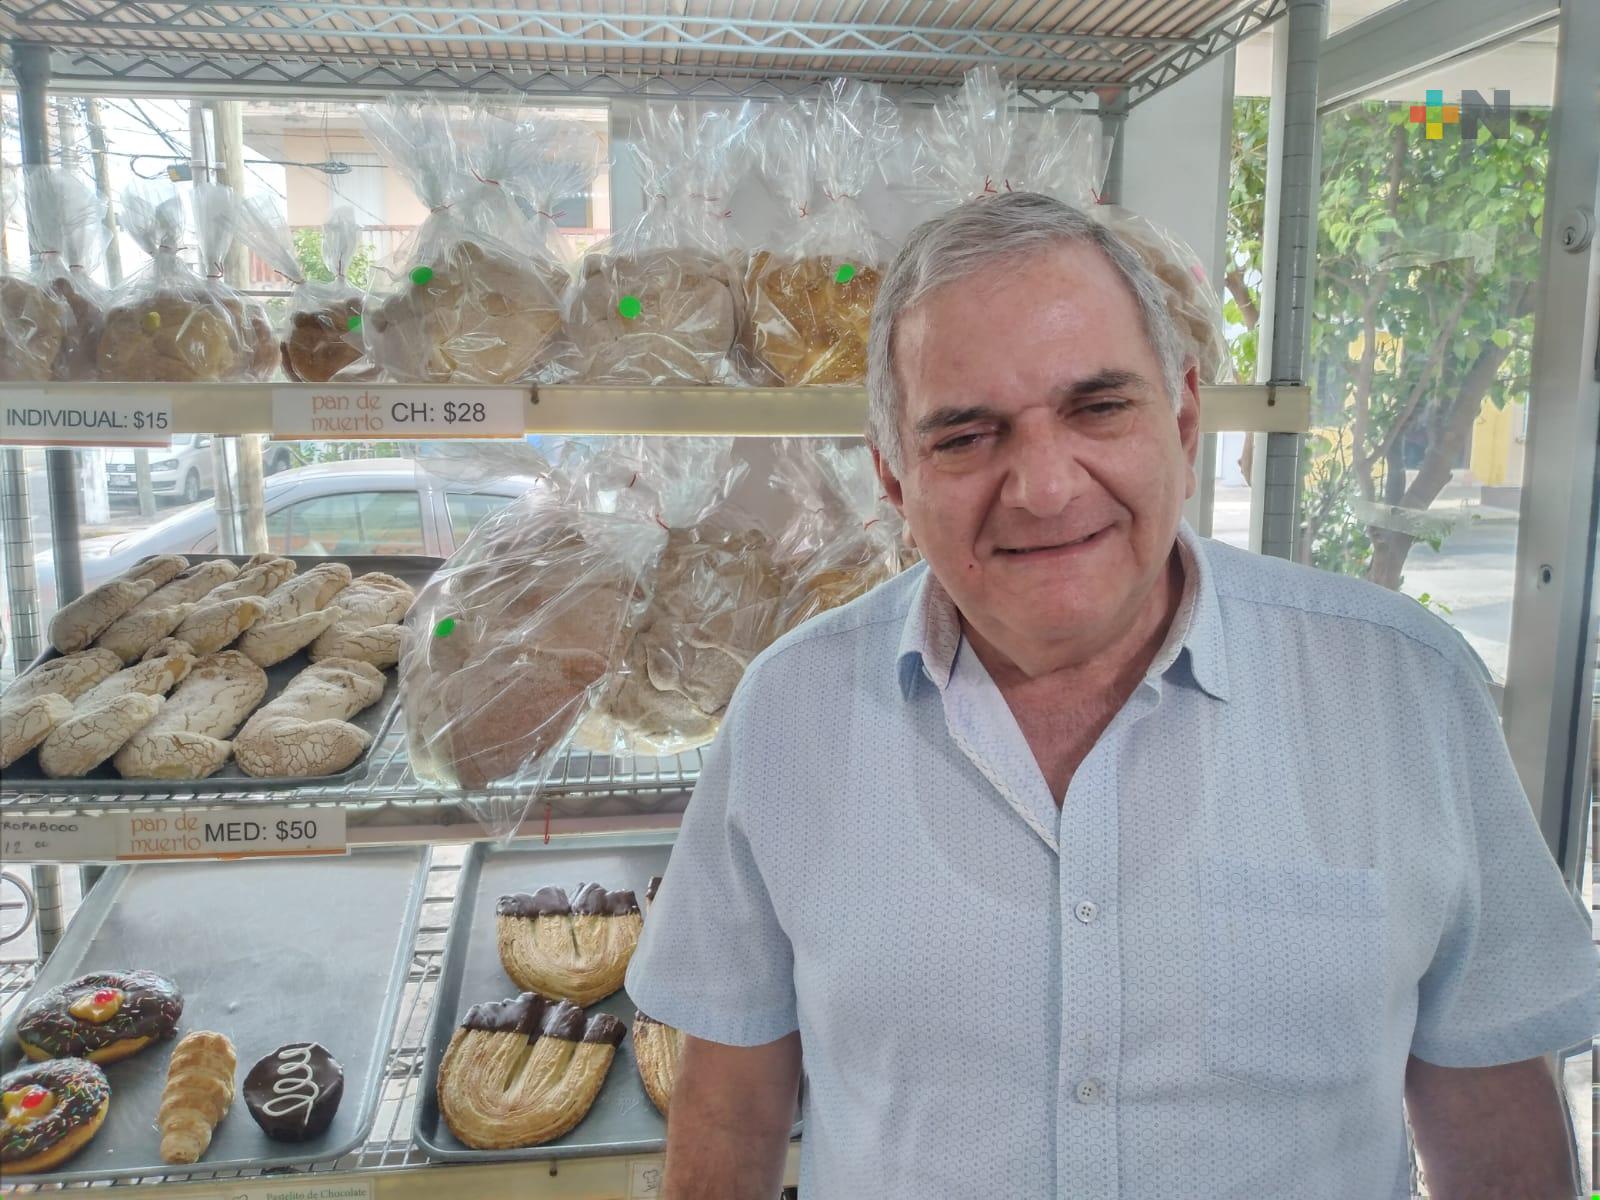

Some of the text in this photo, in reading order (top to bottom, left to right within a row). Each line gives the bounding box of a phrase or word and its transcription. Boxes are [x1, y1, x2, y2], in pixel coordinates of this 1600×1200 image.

[312, 391, 382, 414] pan de
[391, 401, 486, 424] CH: $28
[6, 408, 168, 430] INDIVIDUAL: $15
[312, 413, 384, 432] muerto
[131, 811, 199, 837] pan de
[205, 819, 317, 842] MED: $50
[131, 834, 201, 853] muerto
[307, 1190, 319, 1199] de
[320, 1187, 367, 1198] Chocolate
